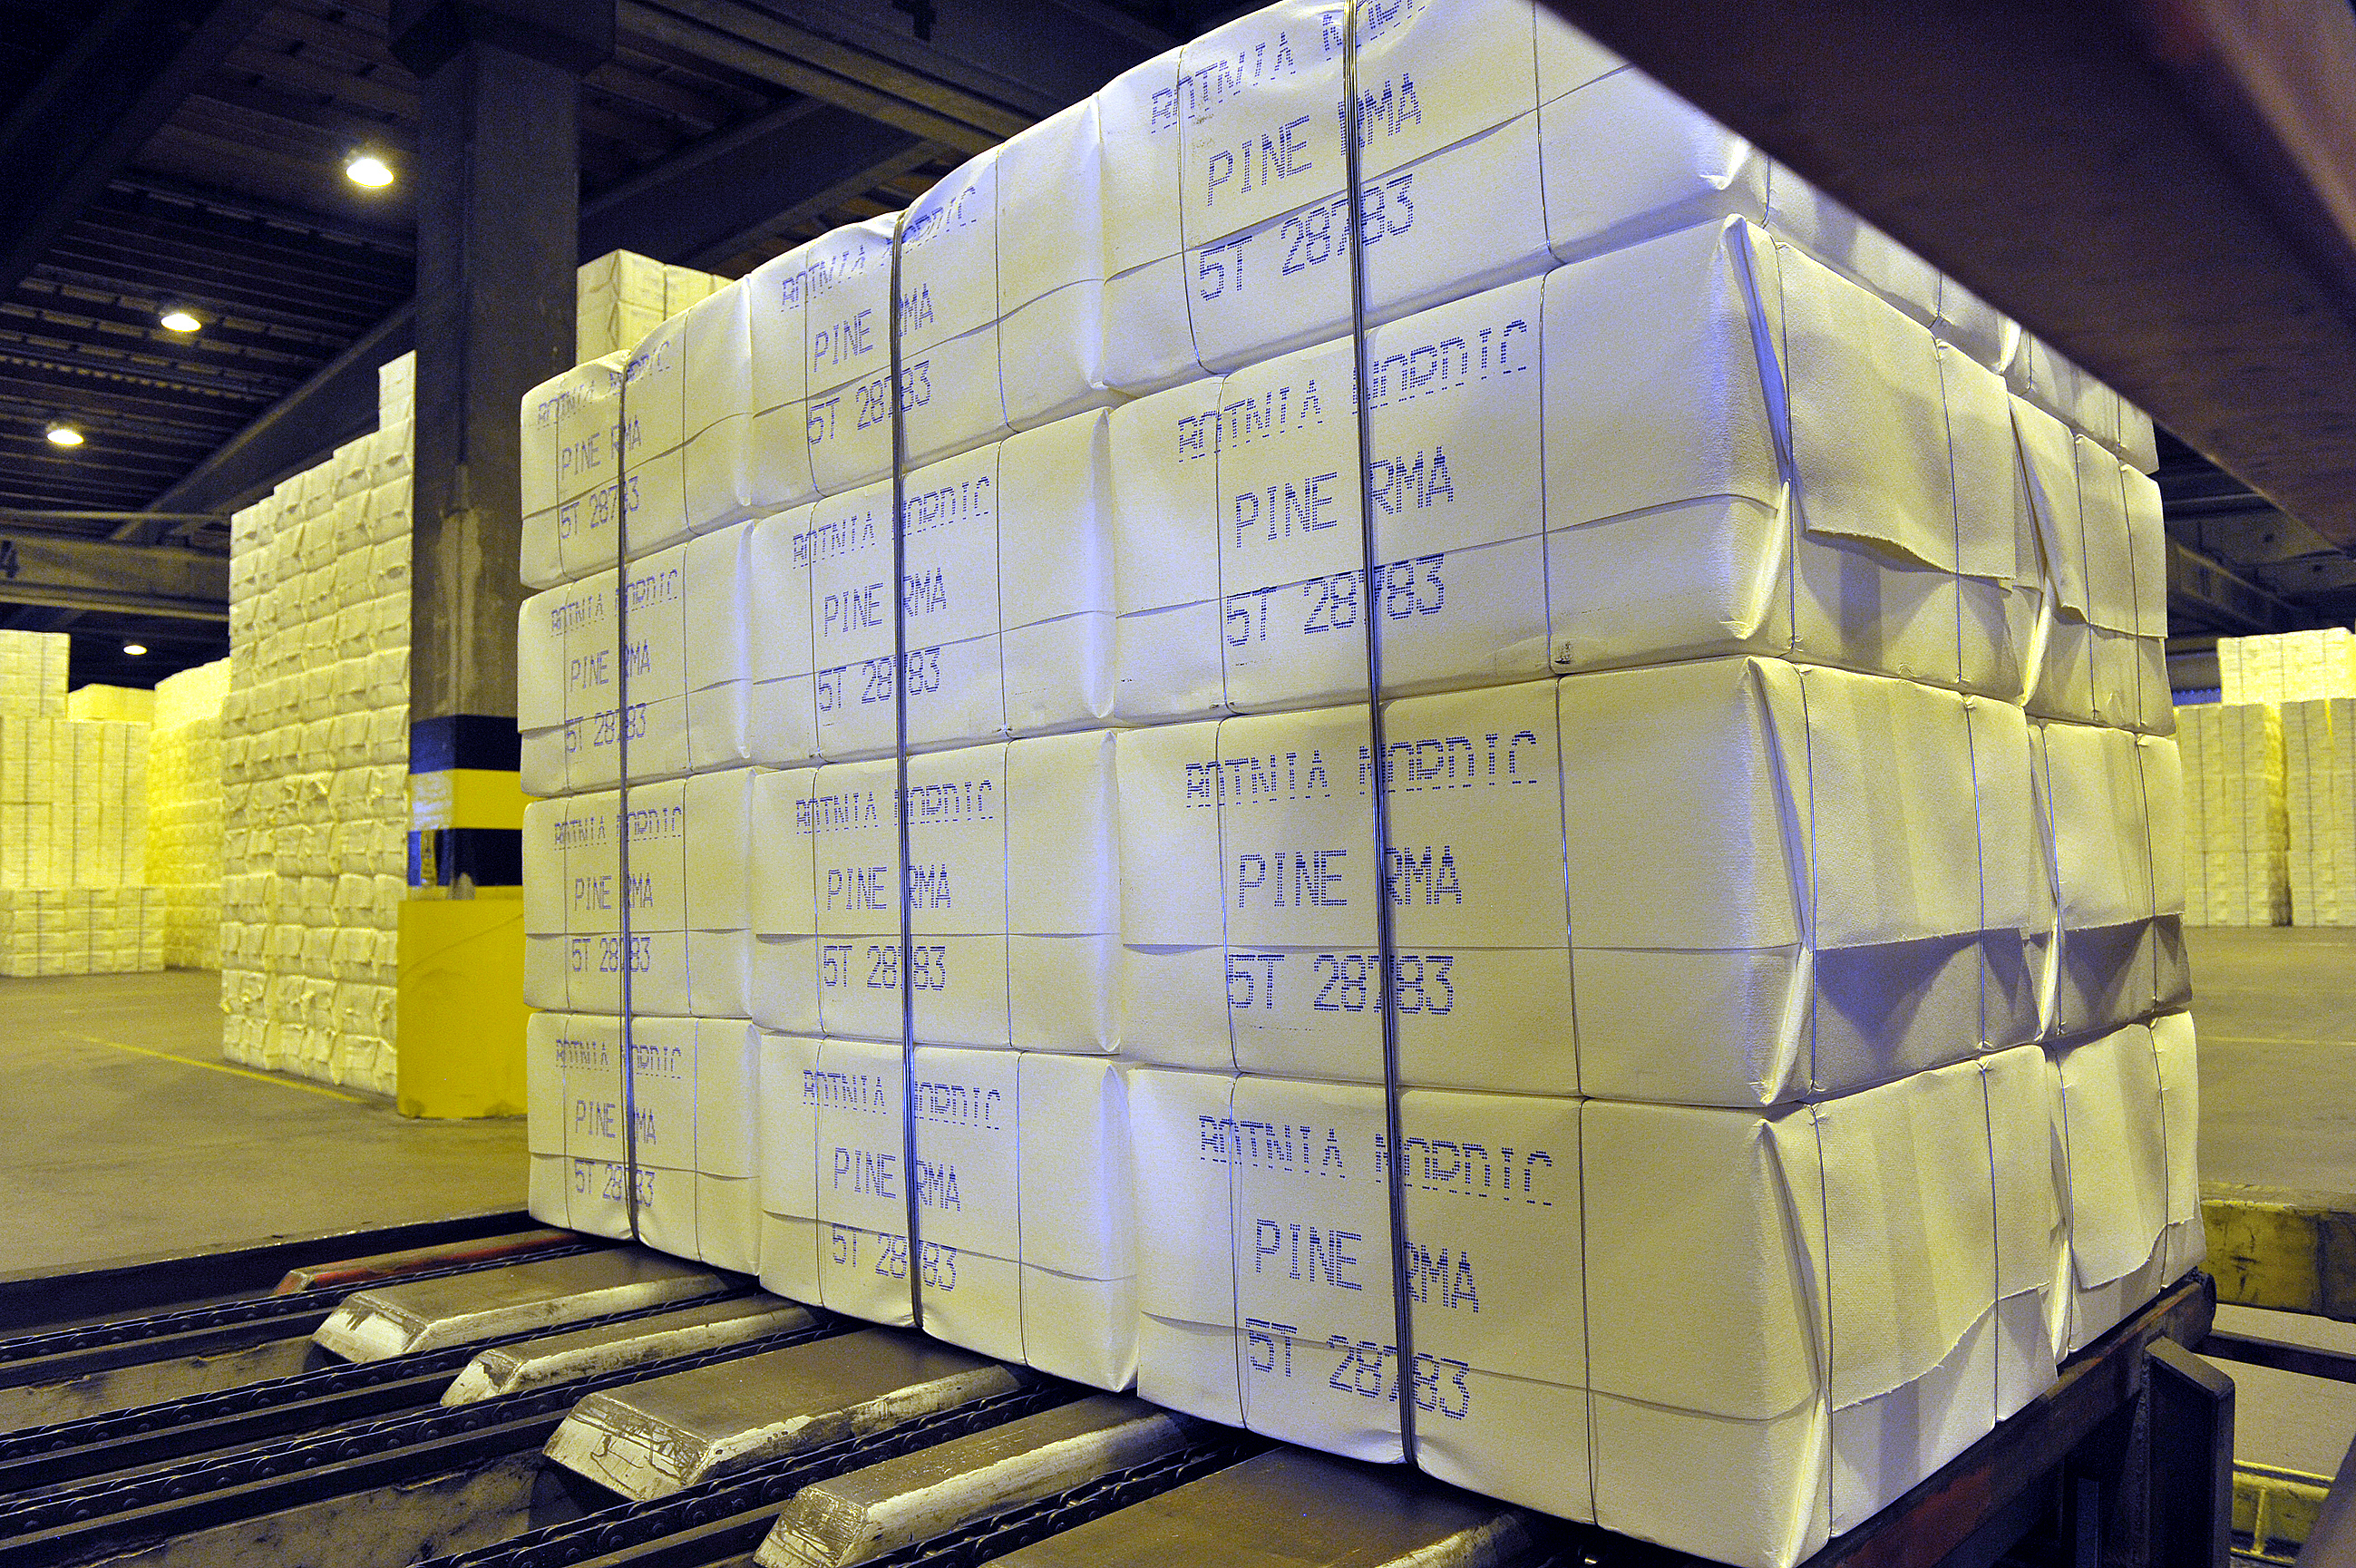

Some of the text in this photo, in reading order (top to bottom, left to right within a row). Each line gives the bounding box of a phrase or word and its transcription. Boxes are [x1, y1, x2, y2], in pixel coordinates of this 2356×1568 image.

[1207, 115, 1312, 207] PINE
[1198, 235, 1253, 301] 5T
[813, 282, 933, 373] PINE MA
[807, 396, 840, 445] 5T
[561, 432, 601, 481] PINE
[560, 501, 579, 540] 5T
[1235, 472, 1338, 549] PINE
[823, 581, 883, 637] PINE
[1226, 586, 1277, 647] 5T
[570, 638, 651, 692] PINE MA
[817, 667, 847, 712] 5T
[574, 872, 654, 911] PINE MA
[826, 866, 888, 911] PINE
[1239, 848, 1348, 908] PINE
[571, 938, 591, 973] 5T
[823, 945, 853, 988] 5T
[1228, 953, 1285, 1009] 5T
[575, 1099, 657, 1145] PINE MA
[574, 1159, 596, 1194] 5T
[833, 1146, 897, 1200] PINE
[1255, 1218, 1362, 1291] PINE
[1245, 1318, 1298, 1378] 5T
